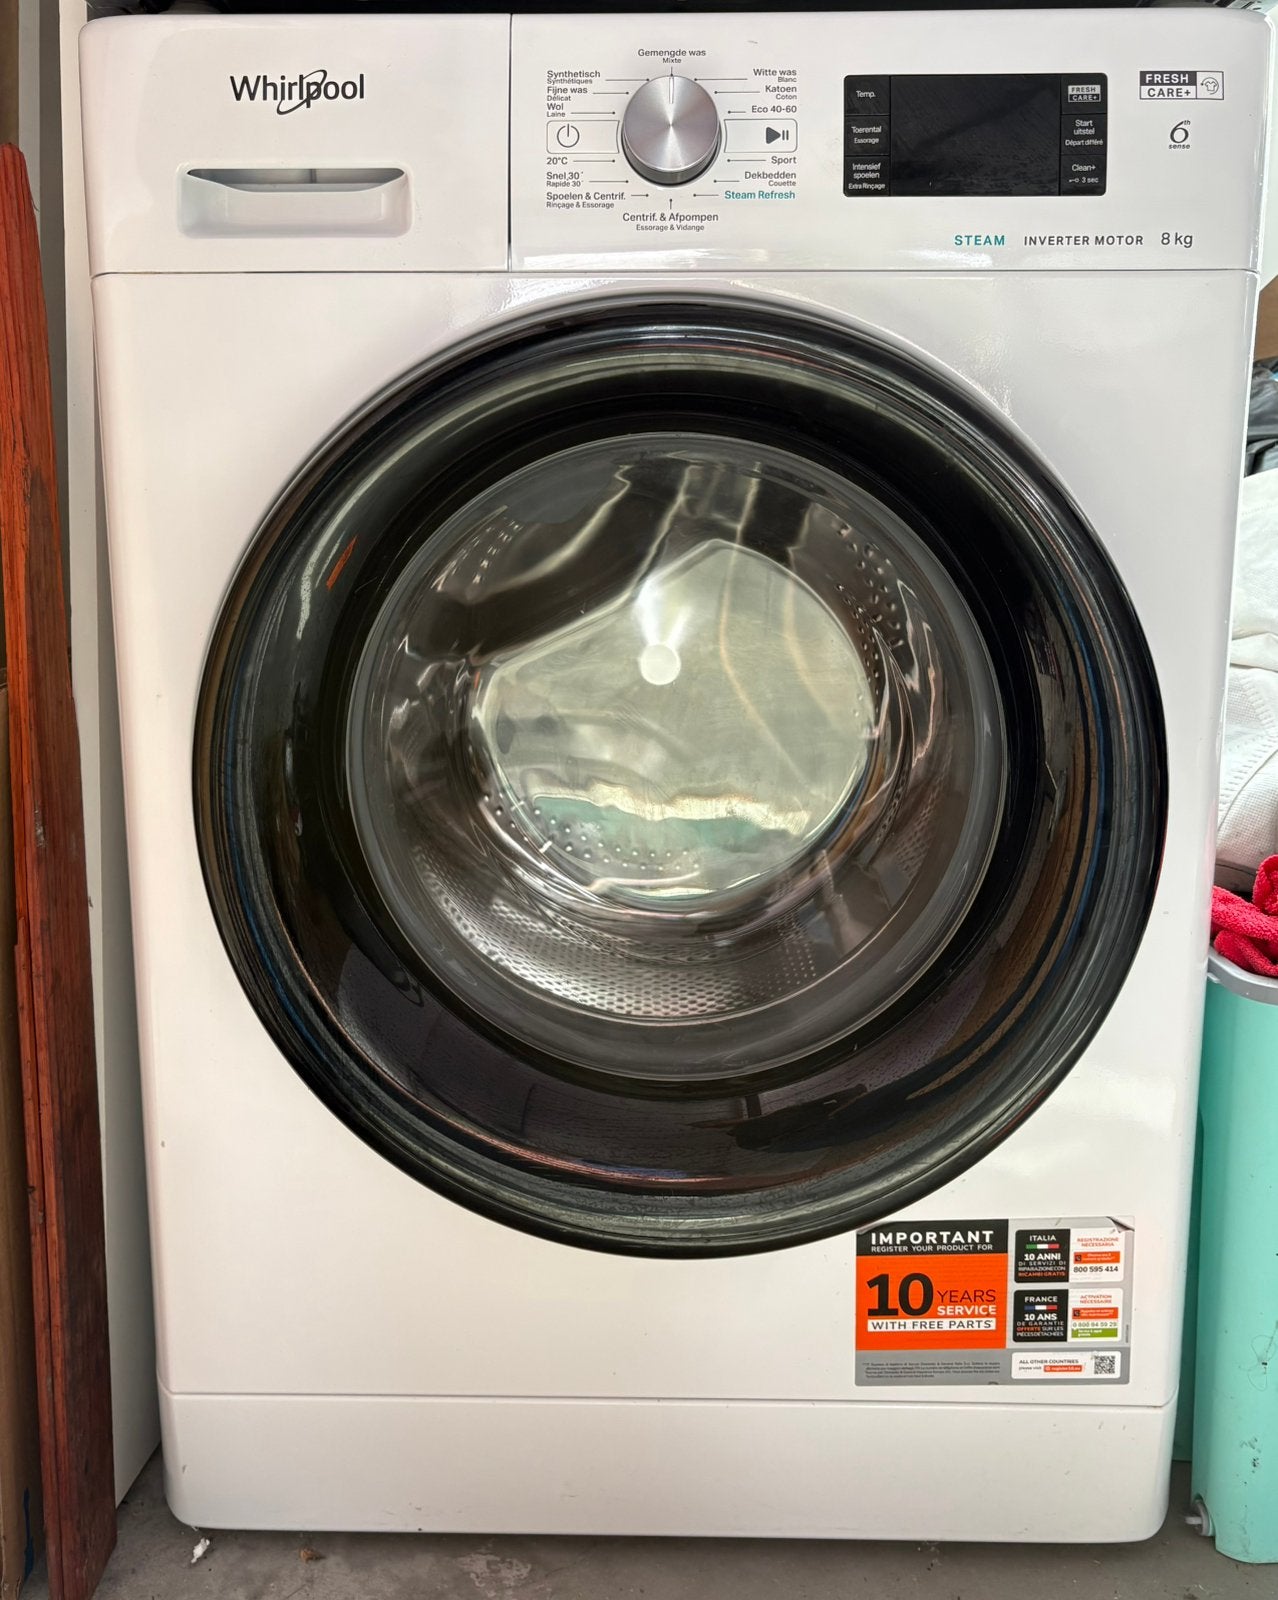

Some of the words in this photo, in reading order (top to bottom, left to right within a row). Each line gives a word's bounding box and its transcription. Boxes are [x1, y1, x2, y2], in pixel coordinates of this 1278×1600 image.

[638, 48, 686, 58] Gemengde
[547, 70, 600, 79] Synthetisch
[753, 68, 777, 76] Witte
[1145, 73, 1189, 84] FRESH
[230, 69, 364, 115] Whirlpool
[547, 86, 568, 95] Fijne
[765, 85, 797, 93] Katoen
[1147, 88, 1191, 97] CARE+
[856, 90, 876, 98] Temp.
[751, 105, 768, 113] Eco
[770, 105, 797, 113] 40-60
[1075, 119, 1093, 127] Start
[546, 157, 568, 165] 20°C
[771, 156, 797, 165] Sport
[852, 162, 881, 171] Intensief
[1072, 164, 1096, 172] Clean+
[547, 172, 566, 180] Snel
[744, 171, 796, 179] Dekbedden
[853, 172, 880, 180] spoelen
[546, 192, 583, 201] Spoelen
[585, 192, 591, 200] &
[593, 192, 626, 200] Centrif.
[725, 190, 756, 199] Steam
[758, 190, 795, 199] Refresh
[622, 212, 657, 221] Centrif.
[660, 213, 666, 221] &
[668, 212, 719, 223] Afpompen
[636, 224, 668, 232] Essorage
[676, 224, 704, 232] Vidange
[954, 235, 1005, 246] STEAM
[1024, 236, 1090, 246] INVERTER
[1095, 235, 1144, 246] MOTOR
[1161, 232, 1170, 245] 8
[1174, 232, 1193, 248] kg
[871, 1231, 994, 1245] IMPORTANT
[1024, 1253, 1035, 1261] 10
[866, 1272, 933, 1316] 10
[937, 1289, 996, 1303] YEARS
[937, 1305, 997, 1316] SERVICE
[871, 1321, 906, 1330] WITH
[912, 1321, 943, 1329] FREE
